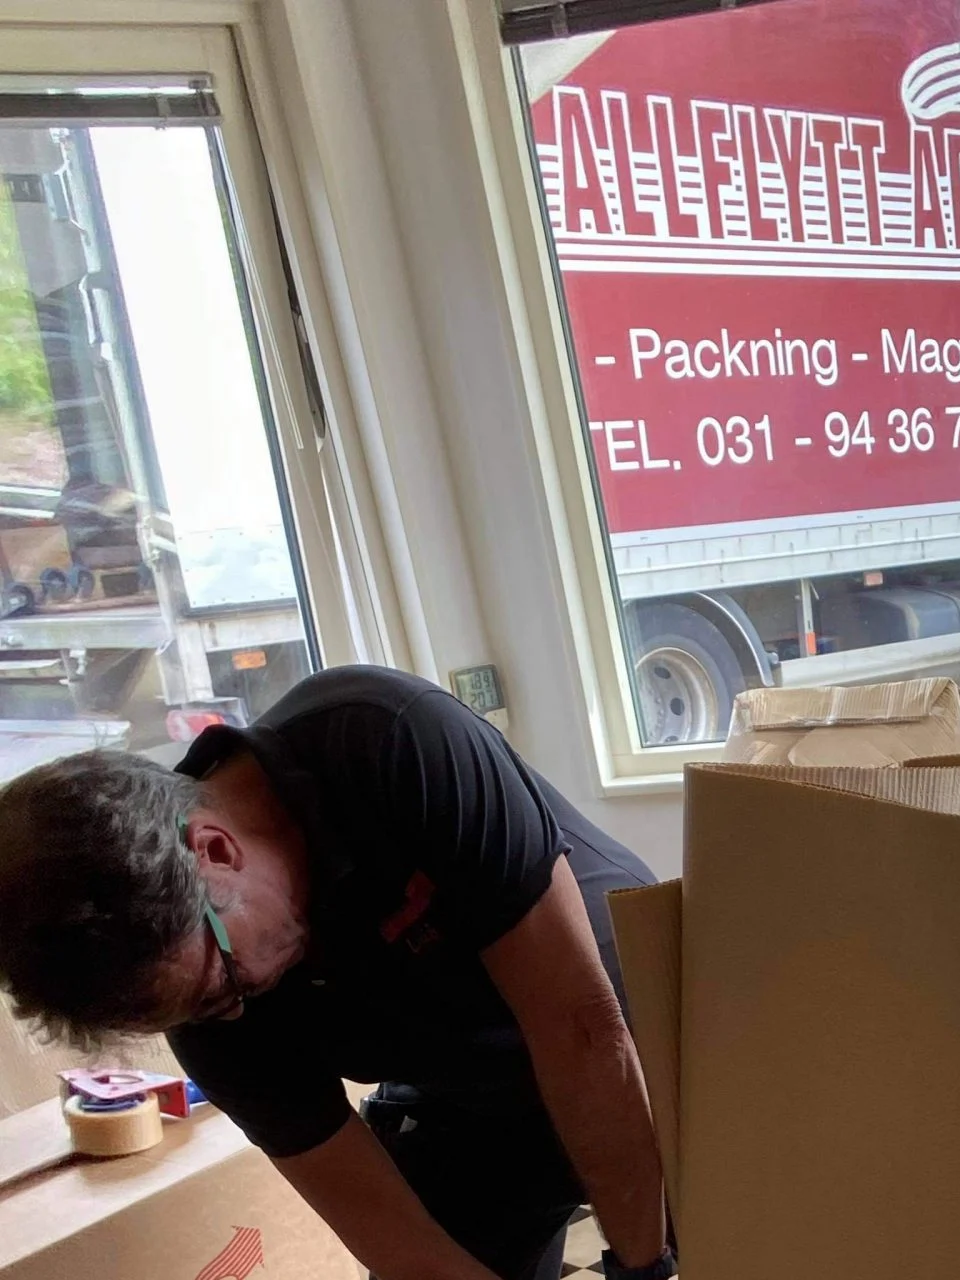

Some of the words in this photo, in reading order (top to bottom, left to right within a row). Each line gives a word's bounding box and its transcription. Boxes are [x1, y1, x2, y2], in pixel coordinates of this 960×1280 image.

[552, 85, 885, 247] ALLFLYTT
[629, 328, 838, 386] Packning
[697, 413, 775, 466] 031
[824, 411, 875, 457] 94
[887, 407, 935, 453] 36
